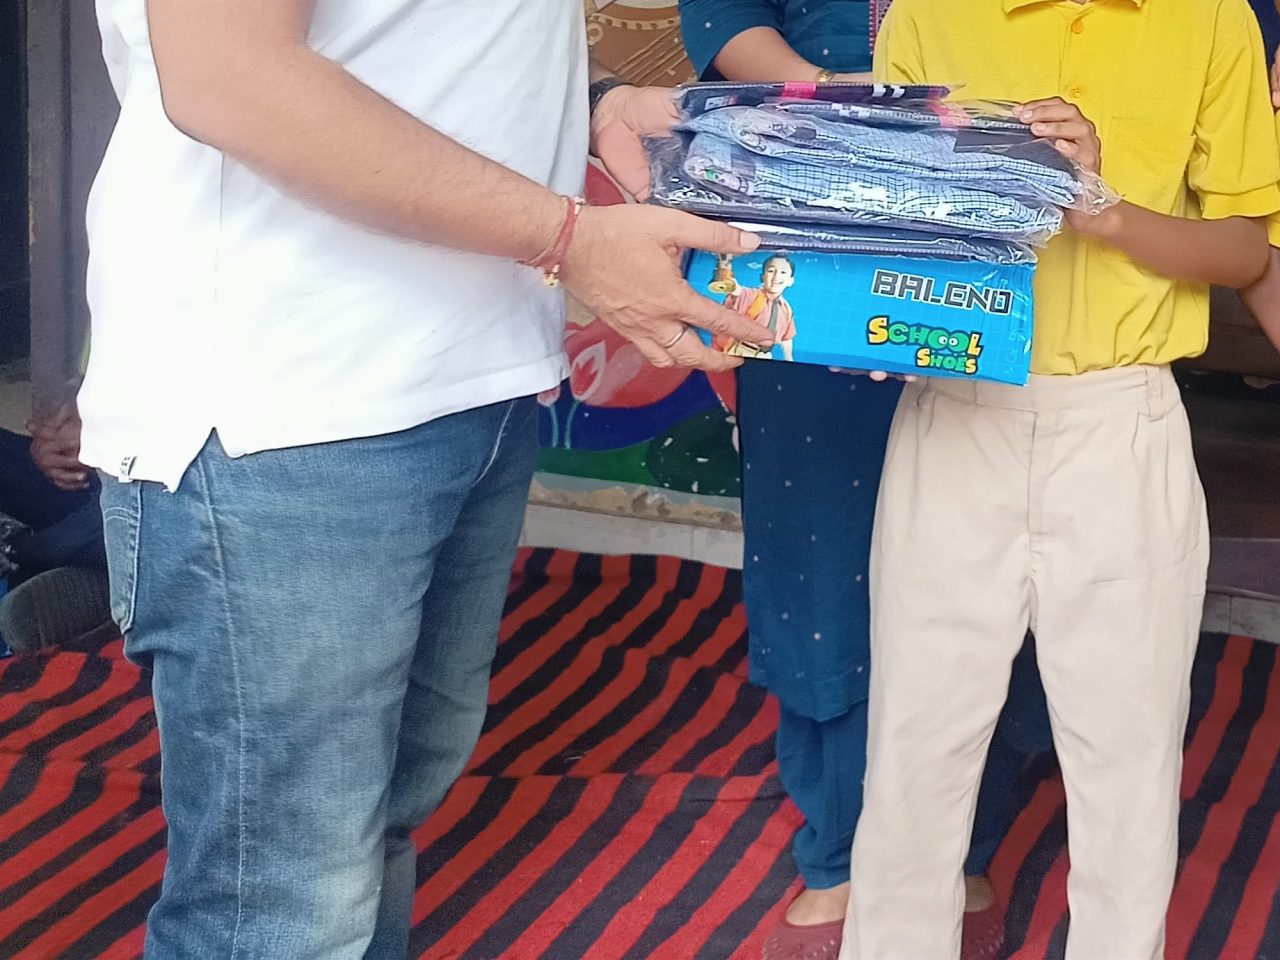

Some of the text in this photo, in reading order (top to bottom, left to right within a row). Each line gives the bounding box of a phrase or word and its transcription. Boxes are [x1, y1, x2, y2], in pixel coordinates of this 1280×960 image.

[871, 268, 1013, 316] BALENO
[866, 315, 984, 356] SCHOOL
[915, 347, 978, 374] SHOES
